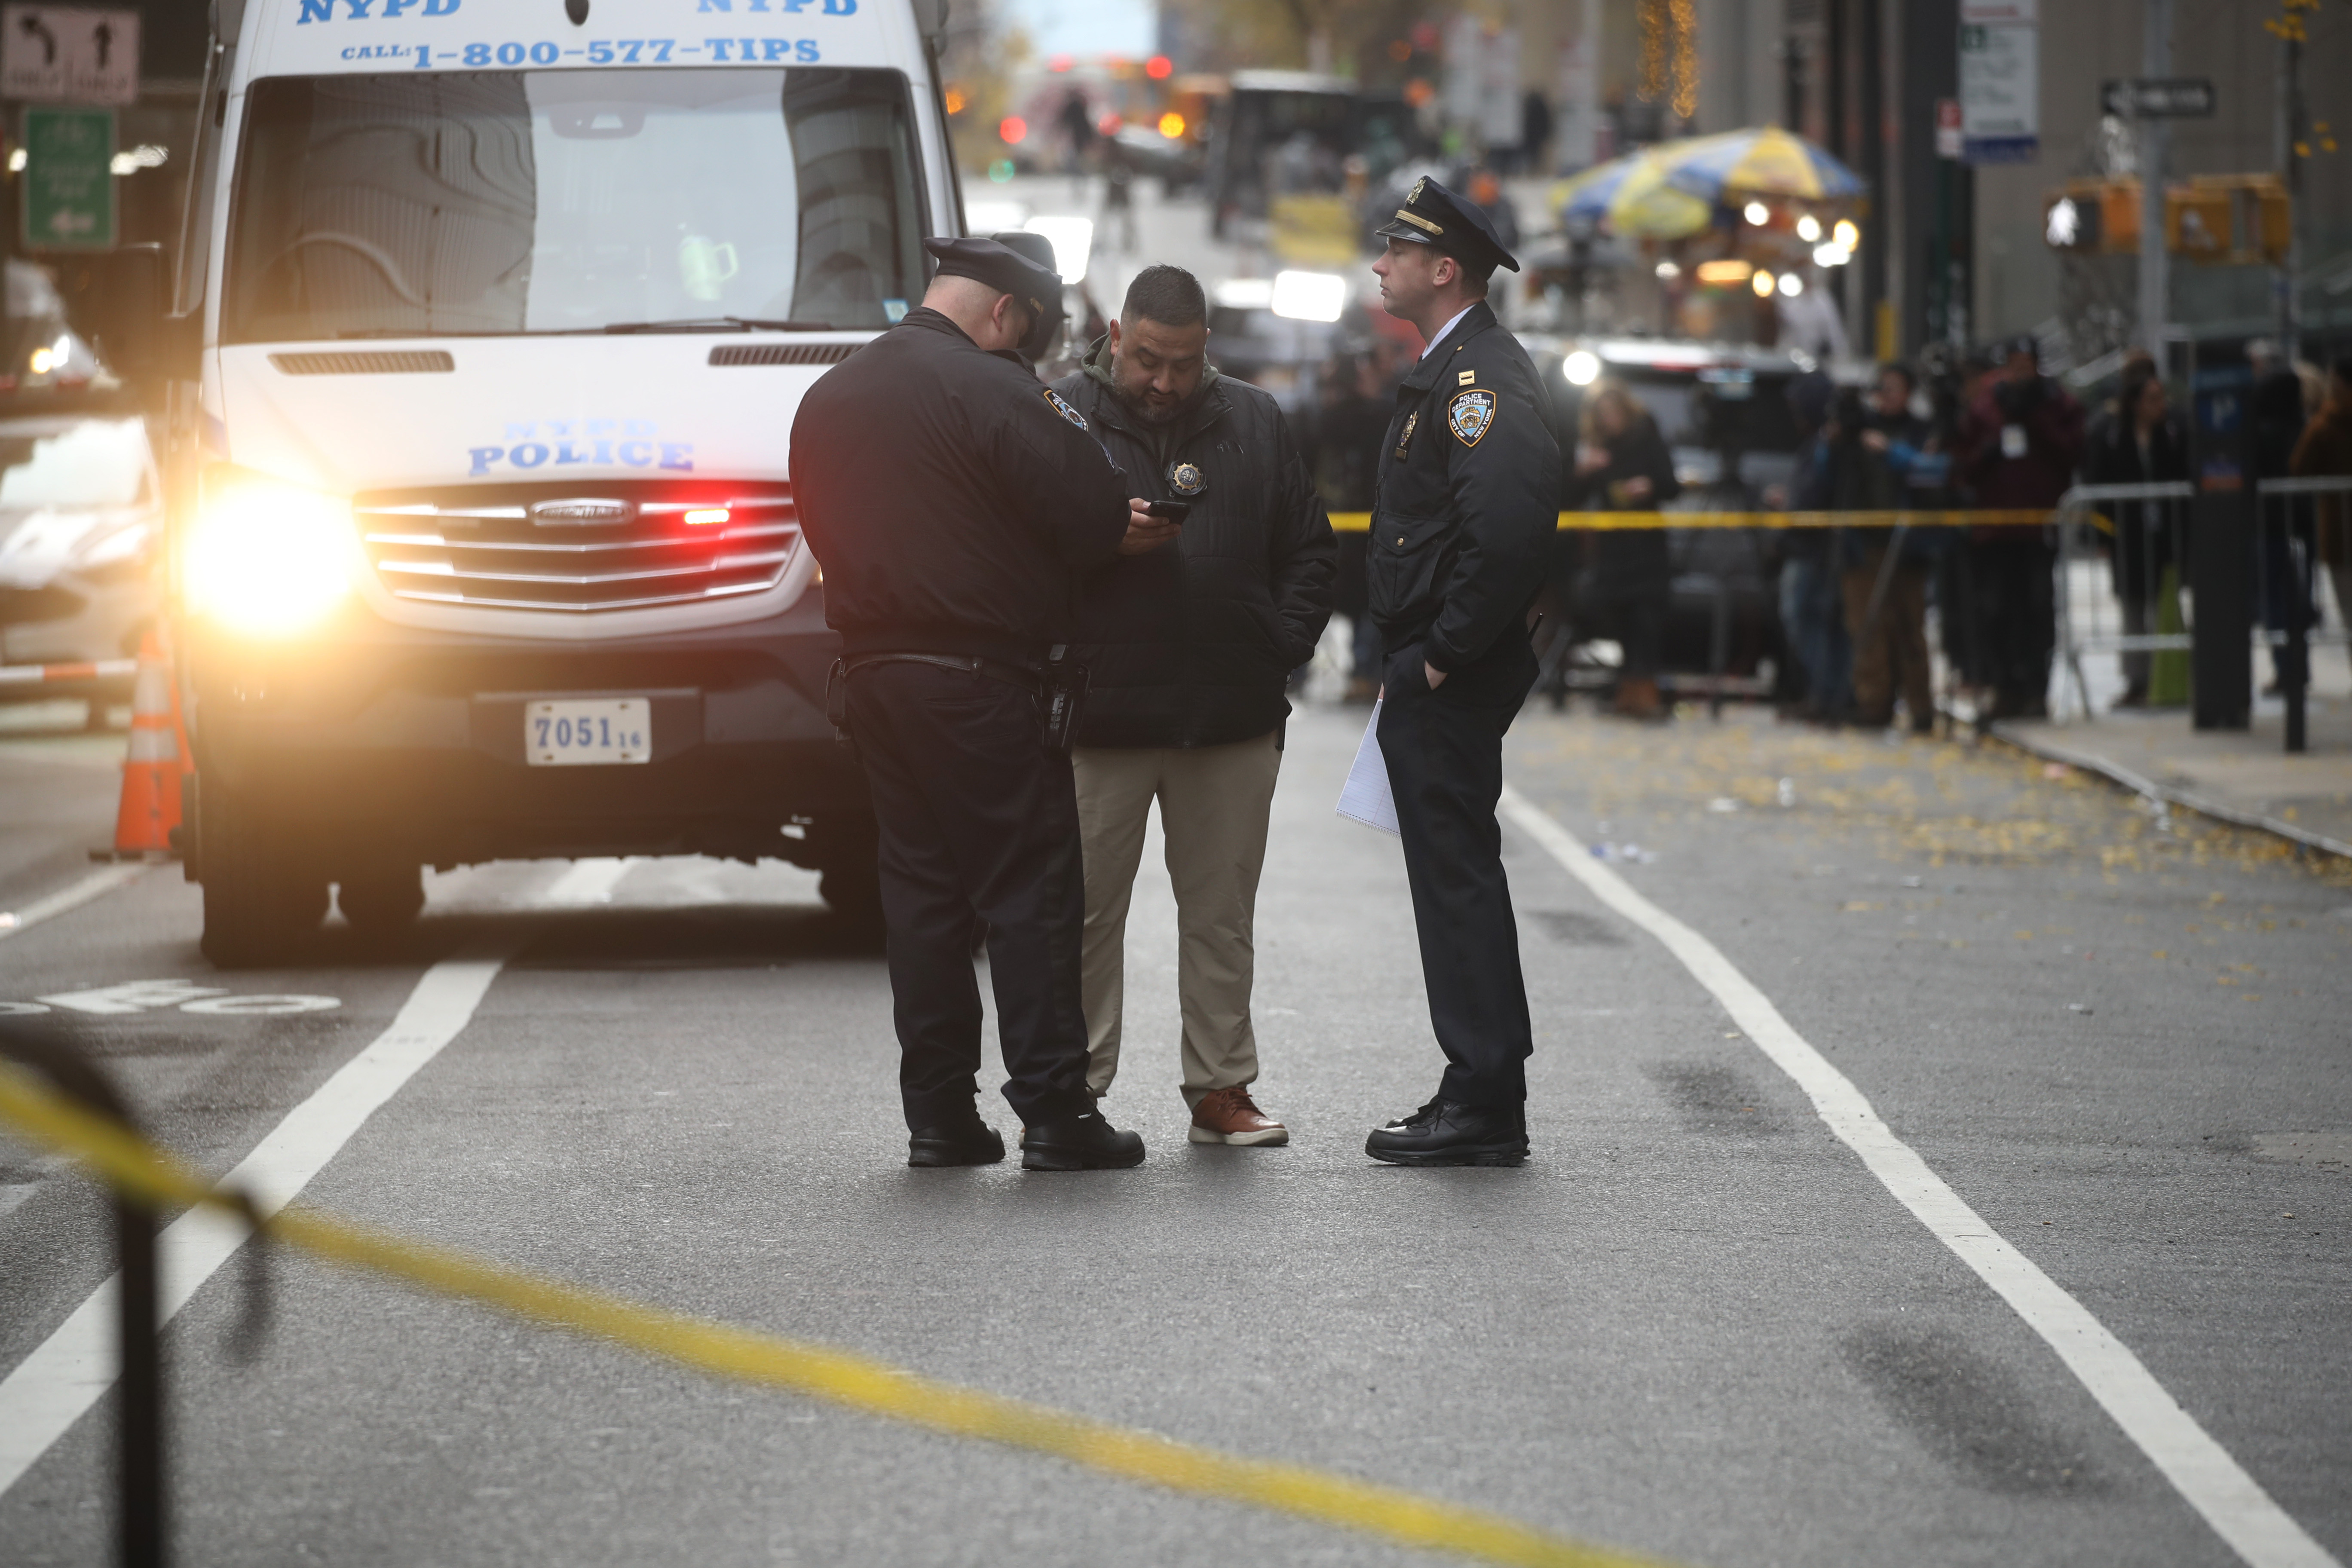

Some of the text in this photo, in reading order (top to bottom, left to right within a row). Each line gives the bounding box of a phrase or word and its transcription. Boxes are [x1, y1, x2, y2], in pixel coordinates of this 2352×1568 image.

[297, 0, 461, 24] NYPD
[414, 38, 821, 68] 1-800-577-TIPS
[1452, 399, 1491, 413] DEPARTMENT
[1459, 393, 1482, 403] POLICE
[505, 419, 658, 440] NYPD
[1451, 418, 1459, 431] CITY
[1474, 409, 1492, 439] NEW YORK
[469, 441, 693, 477] POLICE
[535, 717, 611, 748] 7051
